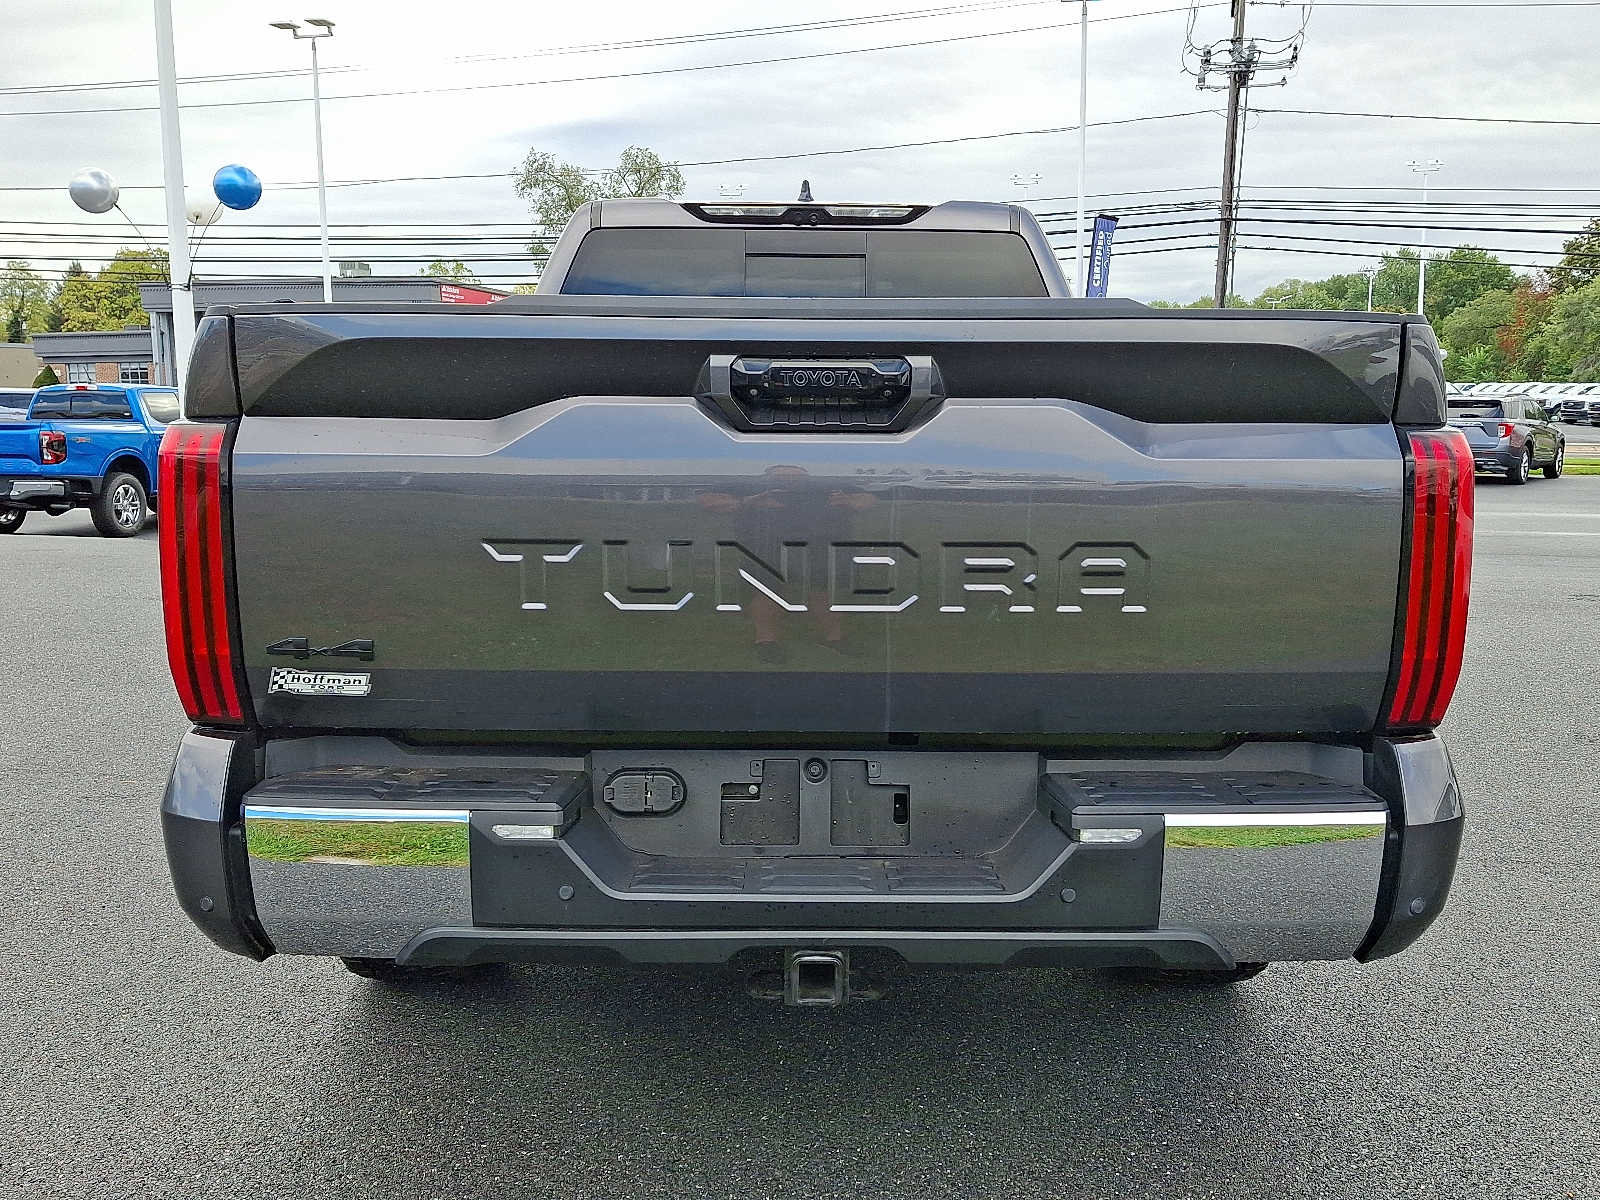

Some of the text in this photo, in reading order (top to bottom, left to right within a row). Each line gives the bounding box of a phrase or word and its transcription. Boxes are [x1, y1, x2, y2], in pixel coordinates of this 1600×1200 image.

[1093, 231, 1103, 286] CERTIFIED
[780, 370, 862, 387] TOYOTA
[481, 538, 1151, 614] TUNDRA
[291, 674, 362, 686] Hoffman
